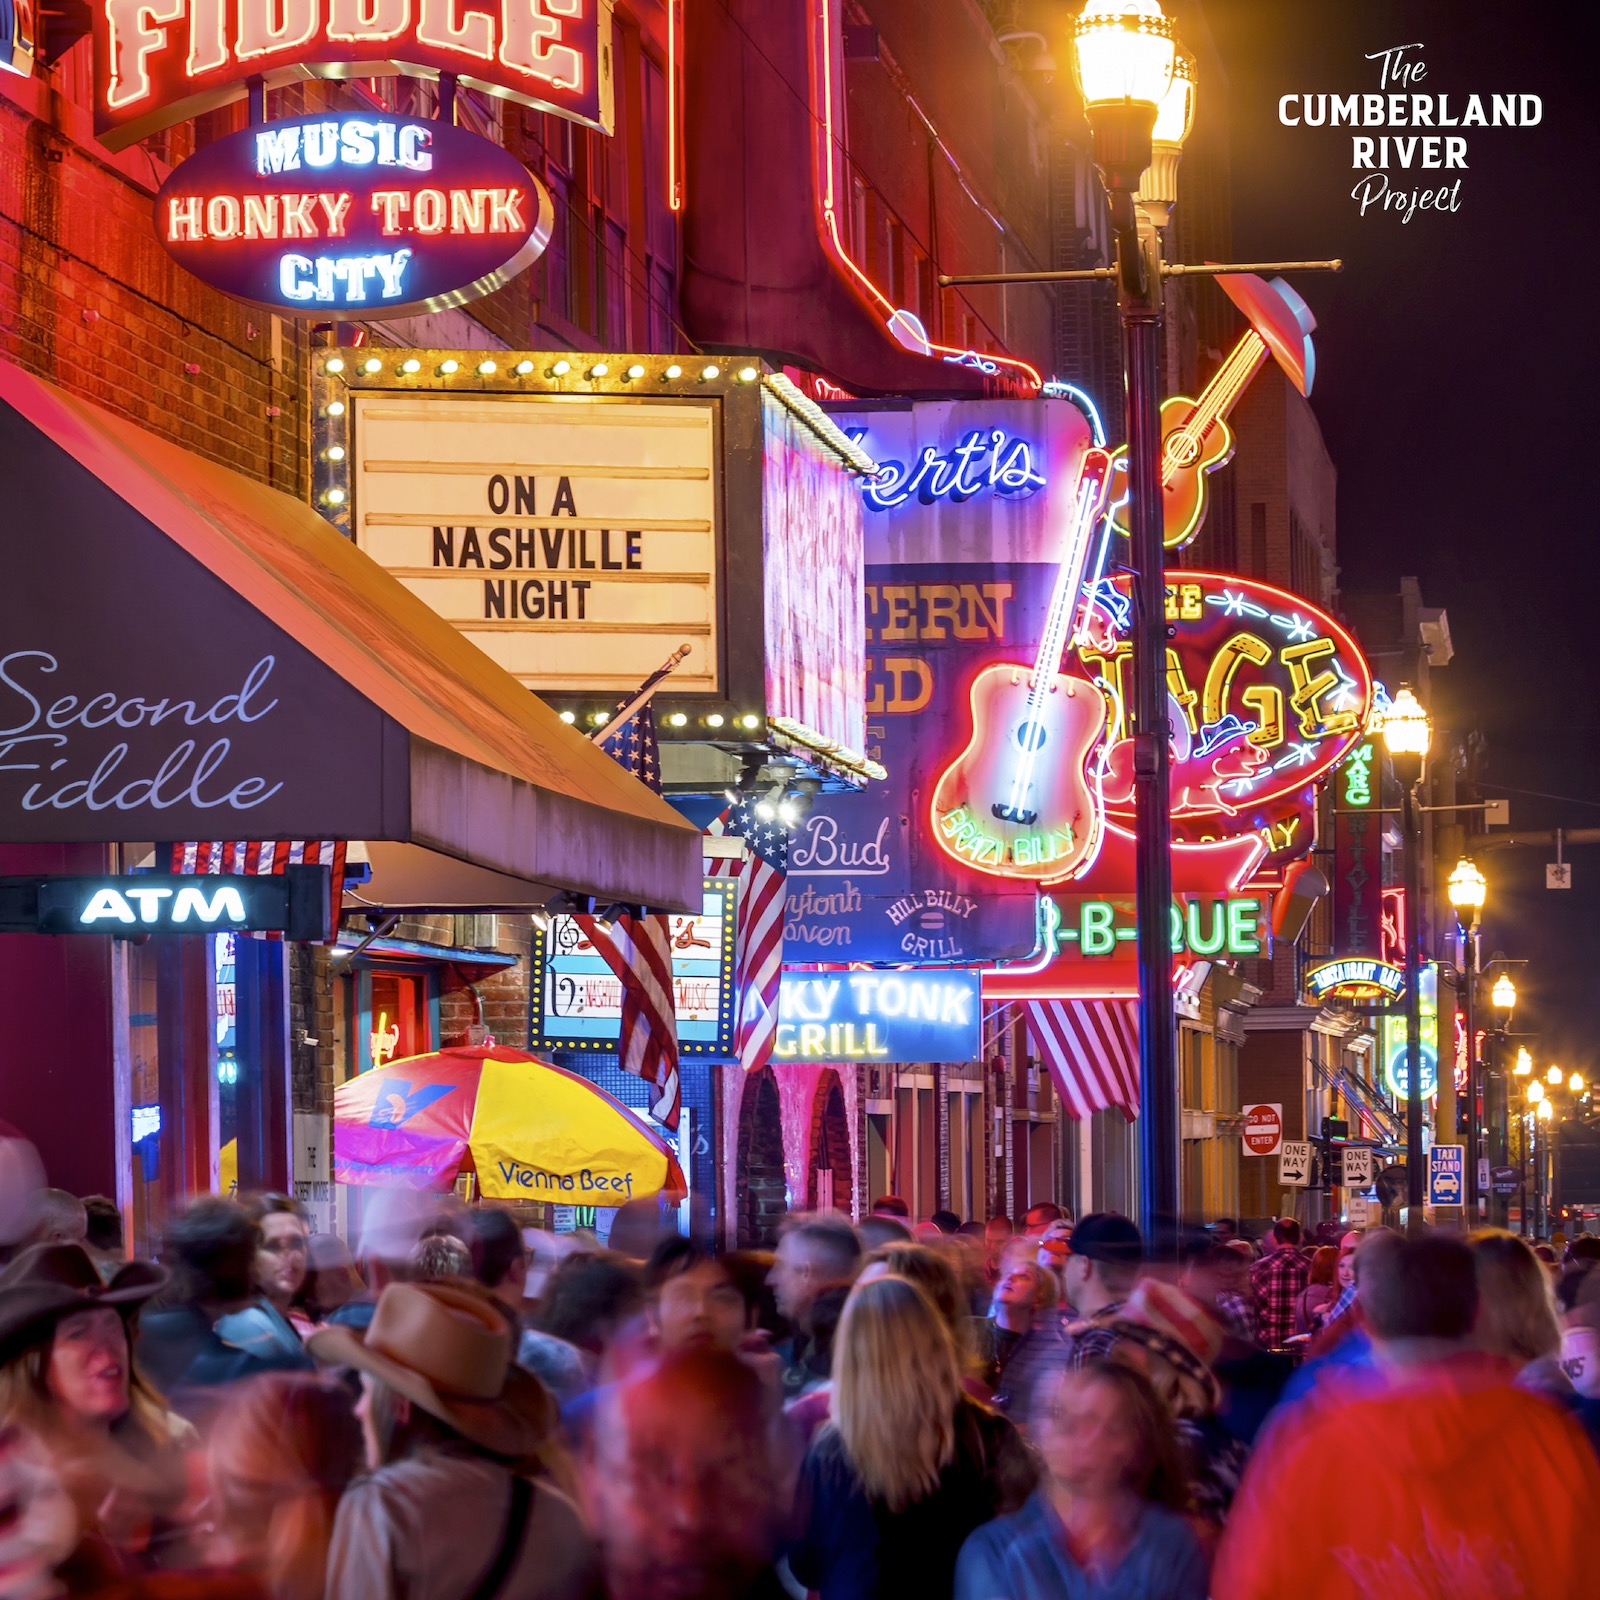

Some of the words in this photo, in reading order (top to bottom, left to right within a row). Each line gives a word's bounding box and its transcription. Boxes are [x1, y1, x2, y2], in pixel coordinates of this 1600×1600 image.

[256, 119, 433, 176] MUSIC
[166, 192, 351, 242] HONKY
[371, 187, 527, 236] TONK
[279, 247, 415, 302] CITY
[487, 474, 537, 515] ON
[551, 476, 577, 517] A
[433, 526, 642, 570] NASHVILLE
[485, 580, 591, 619] NIGHT
[0, 650, 279, 736] Second
[79, 886, 247, 924] ATM
[885, 892, 924, 926] HILL
[924, 889, 979, 919] BILLY
[782, 922, 852, 947] aven
[901, 932, 964, 959] GRILL
[1379, 966, 1402, 991] BAR
[678, 983, 711, 1011] MUSIC
[849, 973, 975, 1028] TONK
[774, 1021, 888, 1057] GRILL
[1261, 1113, 1276, 1123] NOT
[1250, 1136, 1274, 1146] ENTER
[1284, 1145, 1308, 1156] ONE
[1346, 1150, 1369, 1161] ONE
[1436, 1148, 1458, 1160] TAXI
[1283, 1157, 1307, 1169] WAY
[1346, 1162, 1369, 1172] WAY
[1431, 1160, 1461, 1172] STAND
[498, 1161, 575, 1191] Vienna
[580, 1168, 634, 1200] Beef
